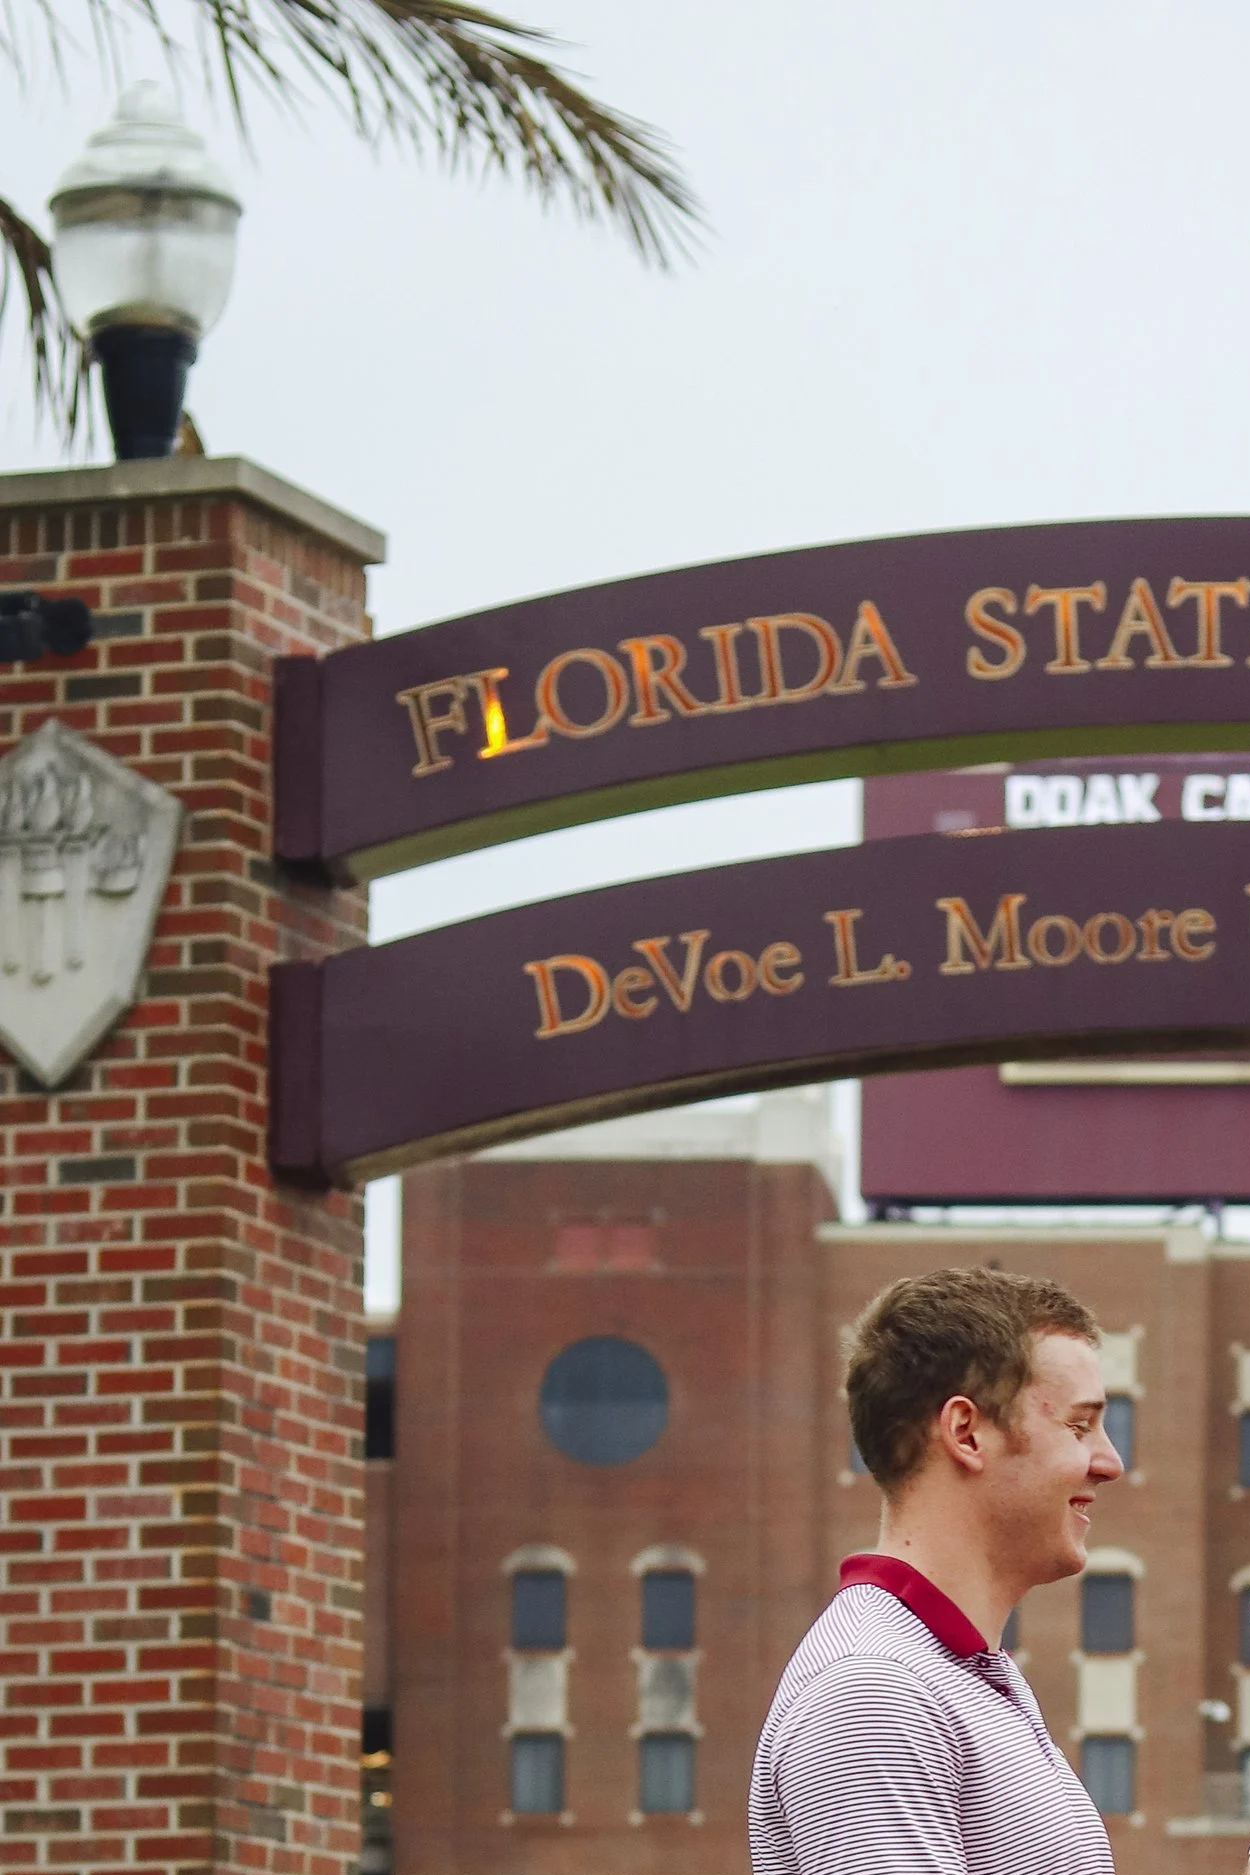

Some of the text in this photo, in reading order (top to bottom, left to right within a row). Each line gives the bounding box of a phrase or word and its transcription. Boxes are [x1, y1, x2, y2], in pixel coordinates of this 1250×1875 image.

[397, 601, 916, 775] FLORIDA
[1005, 774, 1162, 828] DOAK
[524, 931, 804, 1039] DeVoe
[824, 909, 911, 987] L.
[937, 894, 1216, 975] Moore
